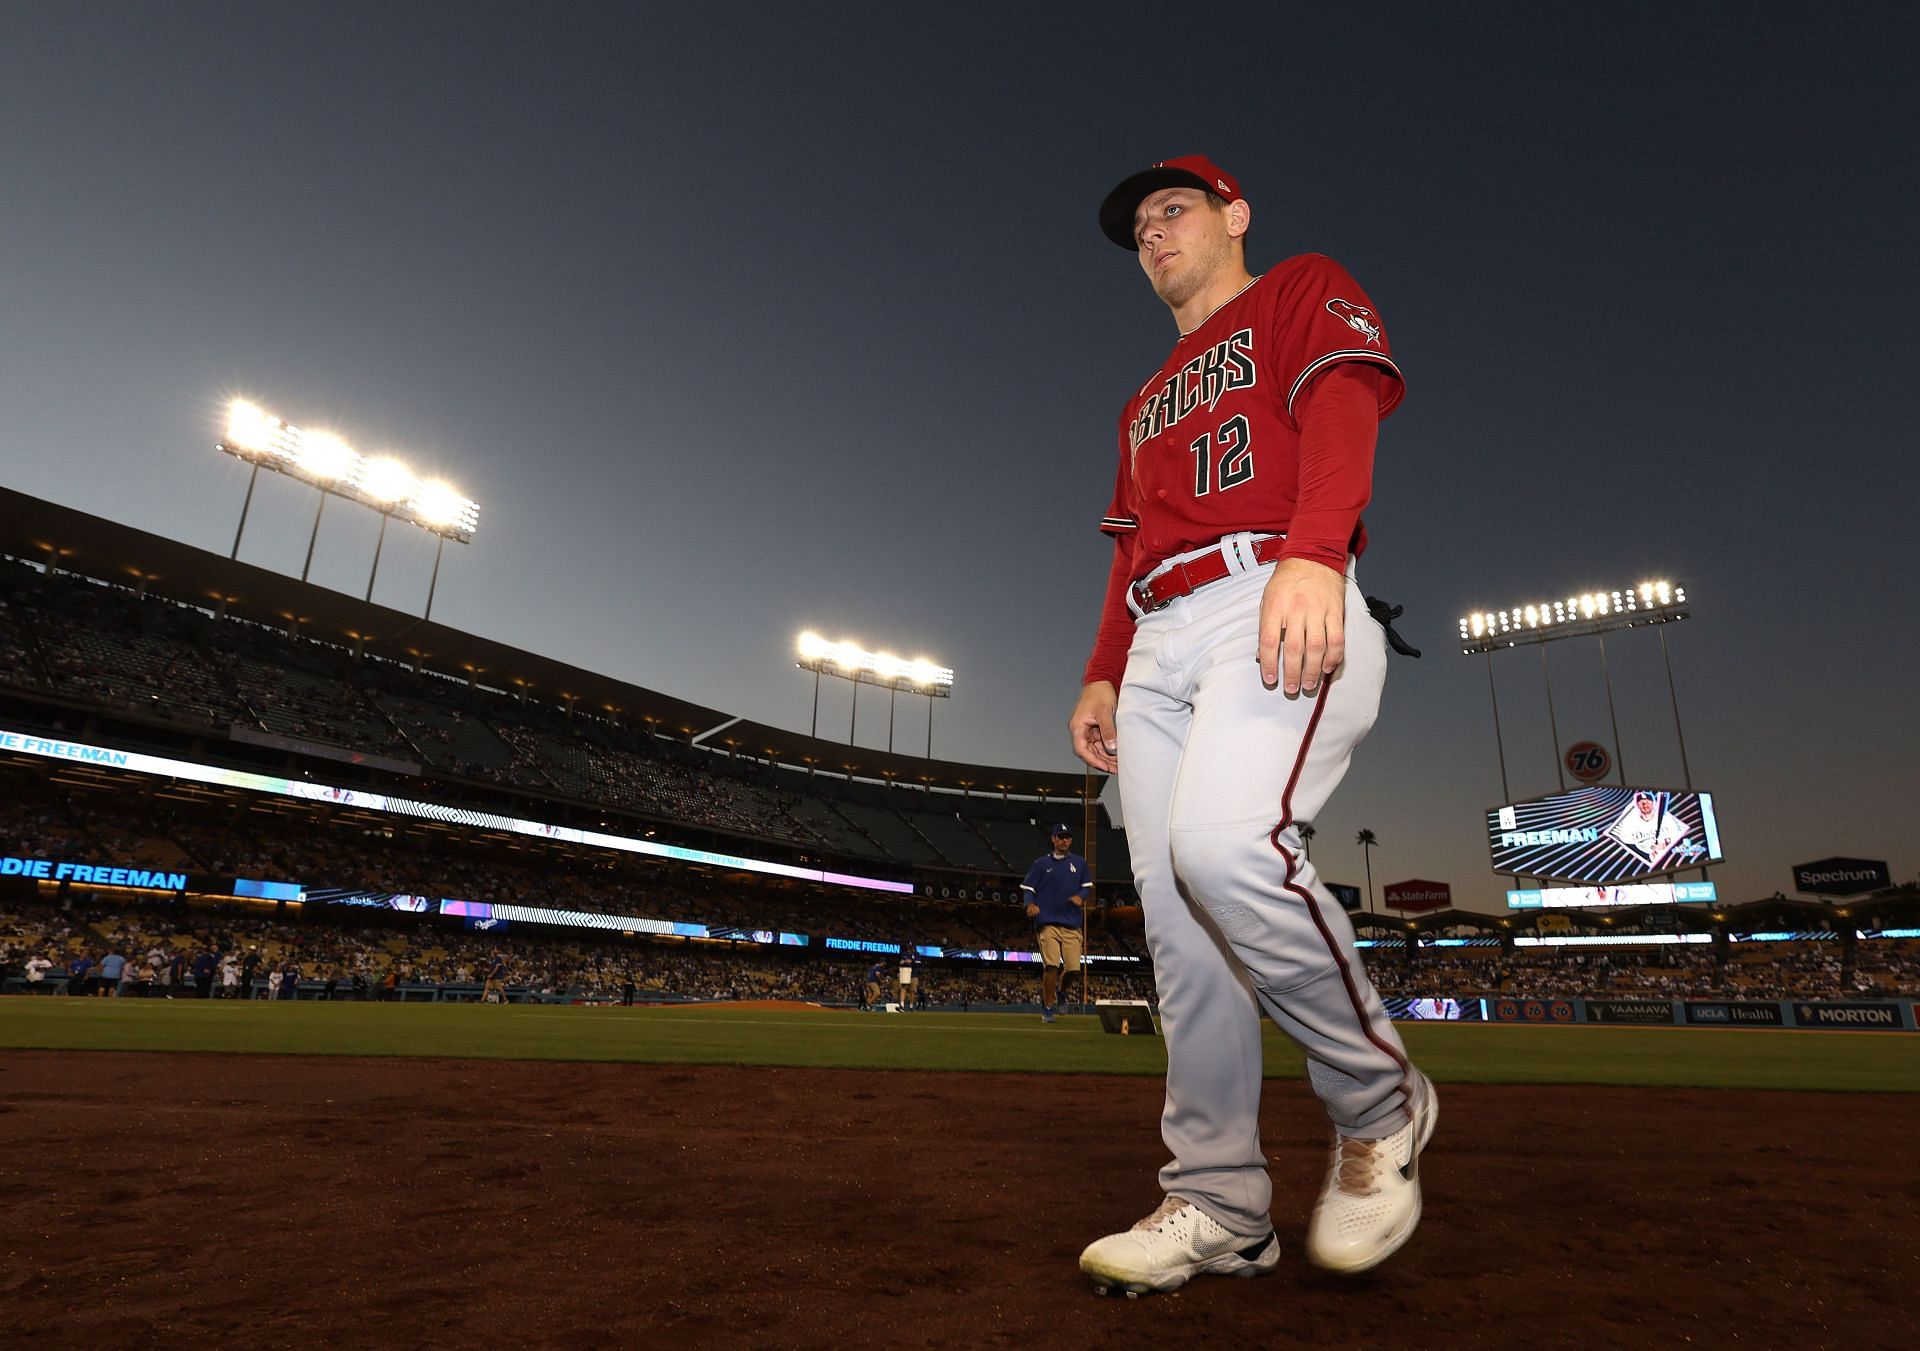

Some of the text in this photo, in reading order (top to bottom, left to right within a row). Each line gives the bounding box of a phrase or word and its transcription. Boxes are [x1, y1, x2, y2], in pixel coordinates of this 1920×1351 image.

[1190, 414, 1255, 498] 12
[23, 737, 128, 766] FREEMAN
[1570, 747, 1605, 772] 76
[1501, 827, 1598, 848] FREEMAN
[0, 857, 187, 890] DIE FREEMAN
[1800, 868, 1878, 886] Spectrum
[825, 938, 901, 955] FREDDIE FREEMAN
[1696, 1007, 1775, 1021] UCLA Health
[1818, 1008, 1893, 1024] MORTON
